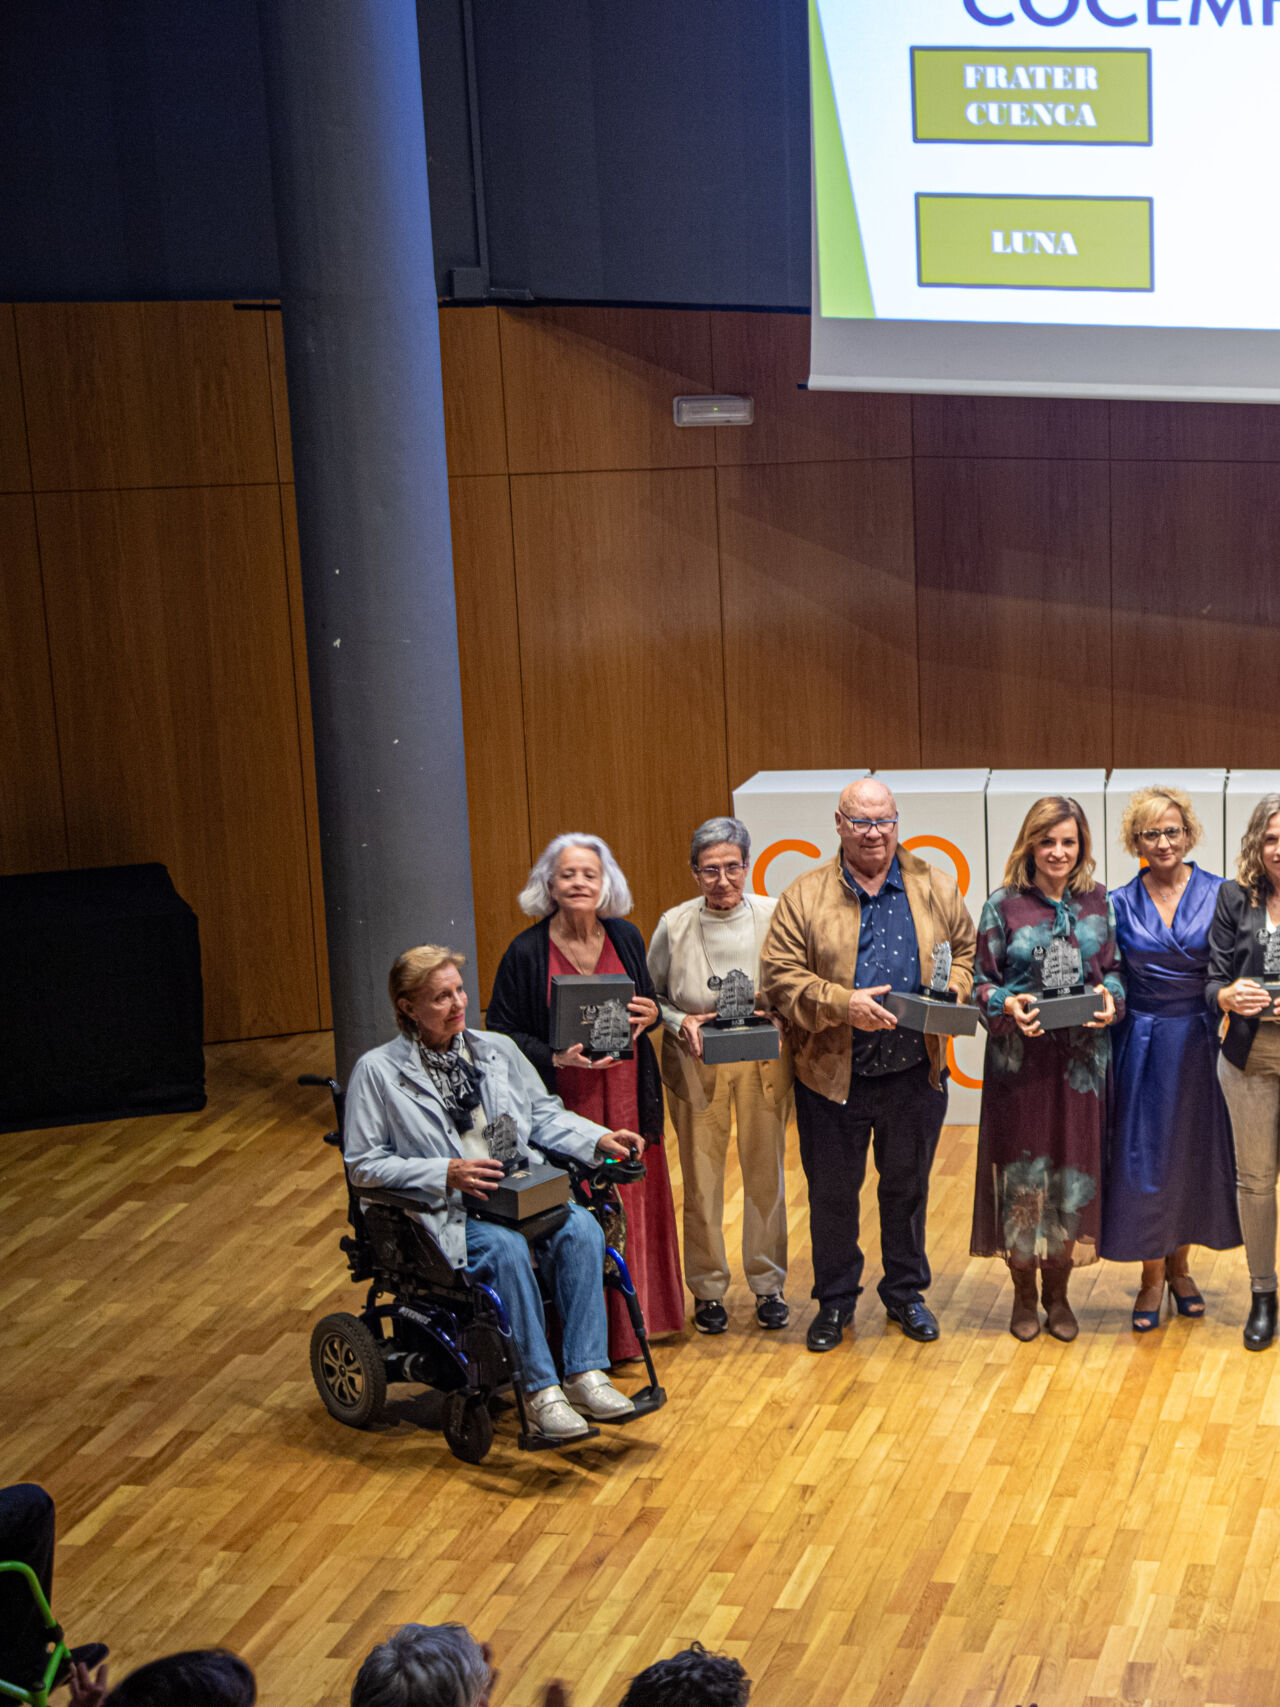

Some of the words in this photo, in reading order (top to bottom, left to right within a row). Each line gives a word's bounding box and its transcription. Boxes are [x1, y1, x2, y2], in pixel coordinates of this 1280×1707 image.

[963, 64, 1099, 90] FRATER
[965, 101, 1098, 127] CUENCA
[991, 230, 1079, 256] LUNA
